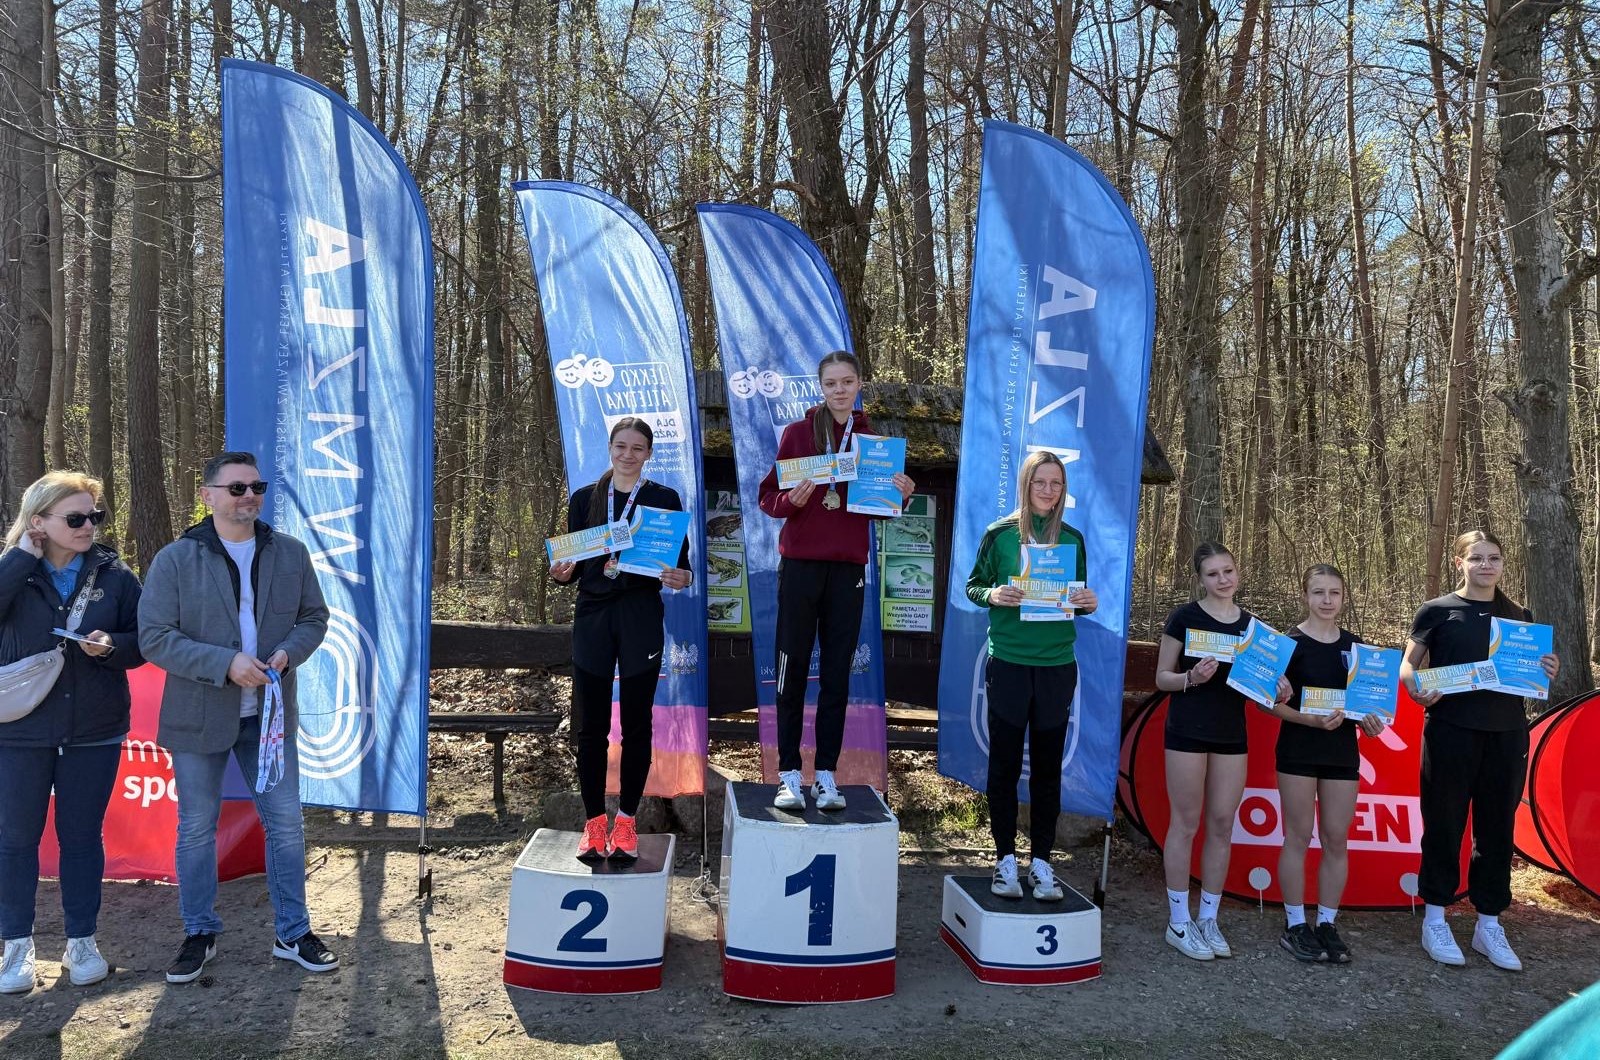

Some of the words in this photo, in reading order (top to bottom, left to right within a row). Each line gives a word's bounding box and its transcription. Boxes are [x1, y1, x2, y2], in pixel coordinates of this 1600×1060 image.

[780, 461, 798, 473] BILET
[799, 459, 809, 470] DO
[550, 536, 569, 551] BILET
[570, 533, 581, 544] DO
[1030, 580, 1040, 590] DO
[1189, 631, 1206, 643] BILET
[1206, 633, 1216, 643] DO
[1417, 670, 1436, 683] BILET
[1436, 668, 1448, 679] DO
[1304, 689, 1321, 700] BILET
[1322, 690, 1332, 701] DO
[1332, 690, 1346, 701] FINA
[1239, 796, 1411, 843] OEN
[785, 854, 836, 946] 1
[557, 889, 609, 953] 2
[1036, 924, 1059, 956] 3
